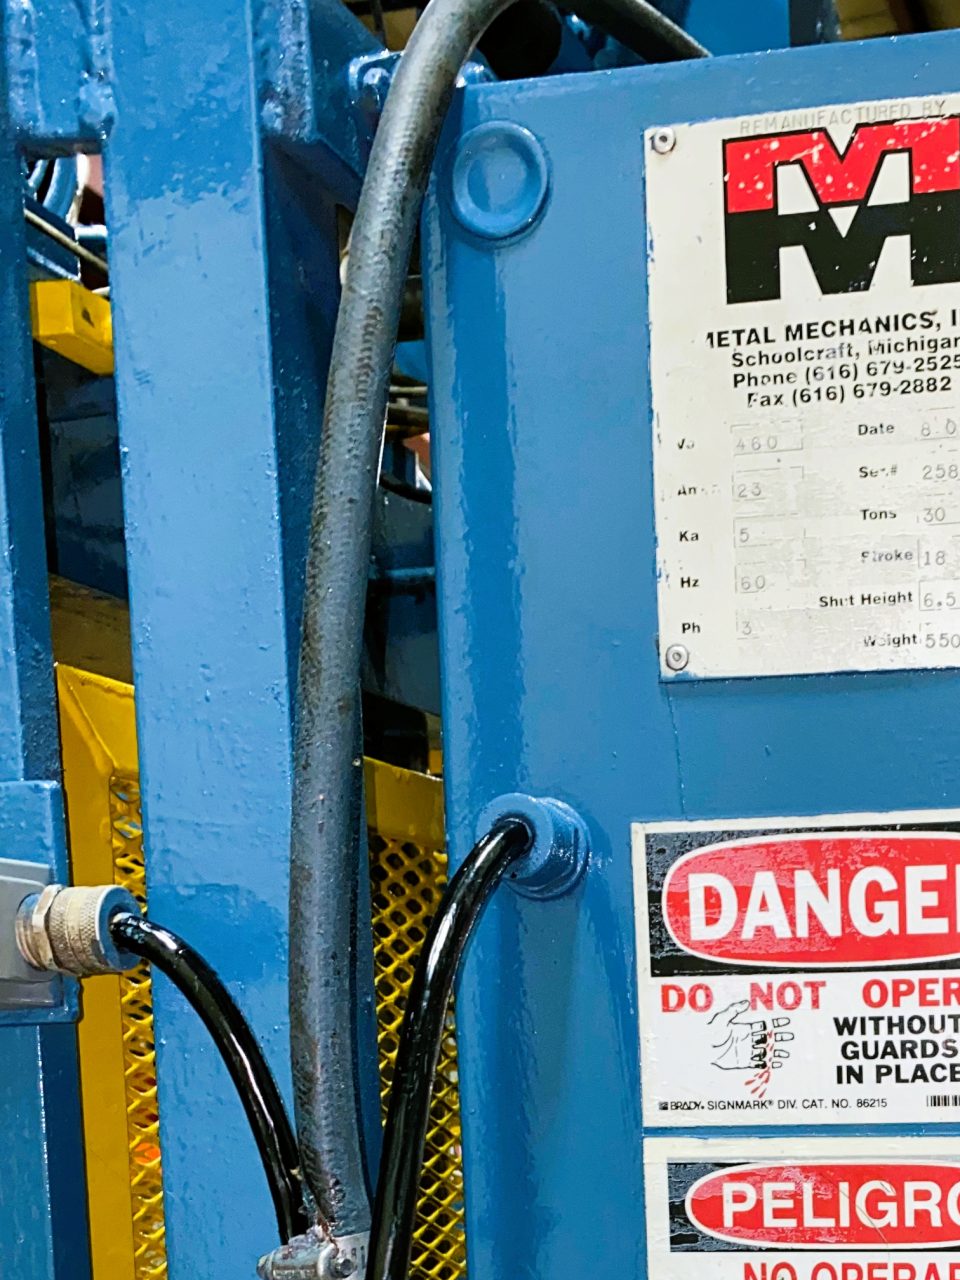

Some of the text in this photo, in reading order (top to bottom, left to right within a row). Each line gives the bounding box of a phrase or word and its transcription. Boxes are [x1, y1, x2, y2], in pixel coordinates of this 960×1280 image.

[922, 99, 946, 118] BY
[785, 310, 941, 342] MECHANICS,
[732, 343, 860, 368] Schoolcraft,
[733, 372, 797, 388] Phone
[805, 363, 858, 386] (616)
[747, 376, 951, 408] Fax (616) 679-2882
[858, 423, 895, 436] Date
[738, 482, 762, 498] 23
[860, 506, 946, 523] Tons 30
[739, 528, 750, 543] 5
[923, 550, 947, 567] 18
[680, 575, 766, 590] Hz 60
[861, 591, 913, 607] Height
[923, 591, 957, 608] 6.5
[681, 620, 752, 636] Ph 3
[660, 982, 715, 1013] DO
[749, 980, 827, 1011] NOT
[840, 1038, 959, 1061] GUARDS
[835, 1065, 864, 1084] IN
[778, 1099, 798, 1110] DIV.
[802, 1099, 828, 1109] CAT.
[832, 1099, 852, 1109] NO.
[856, 1098, 888, 1108] 86215
